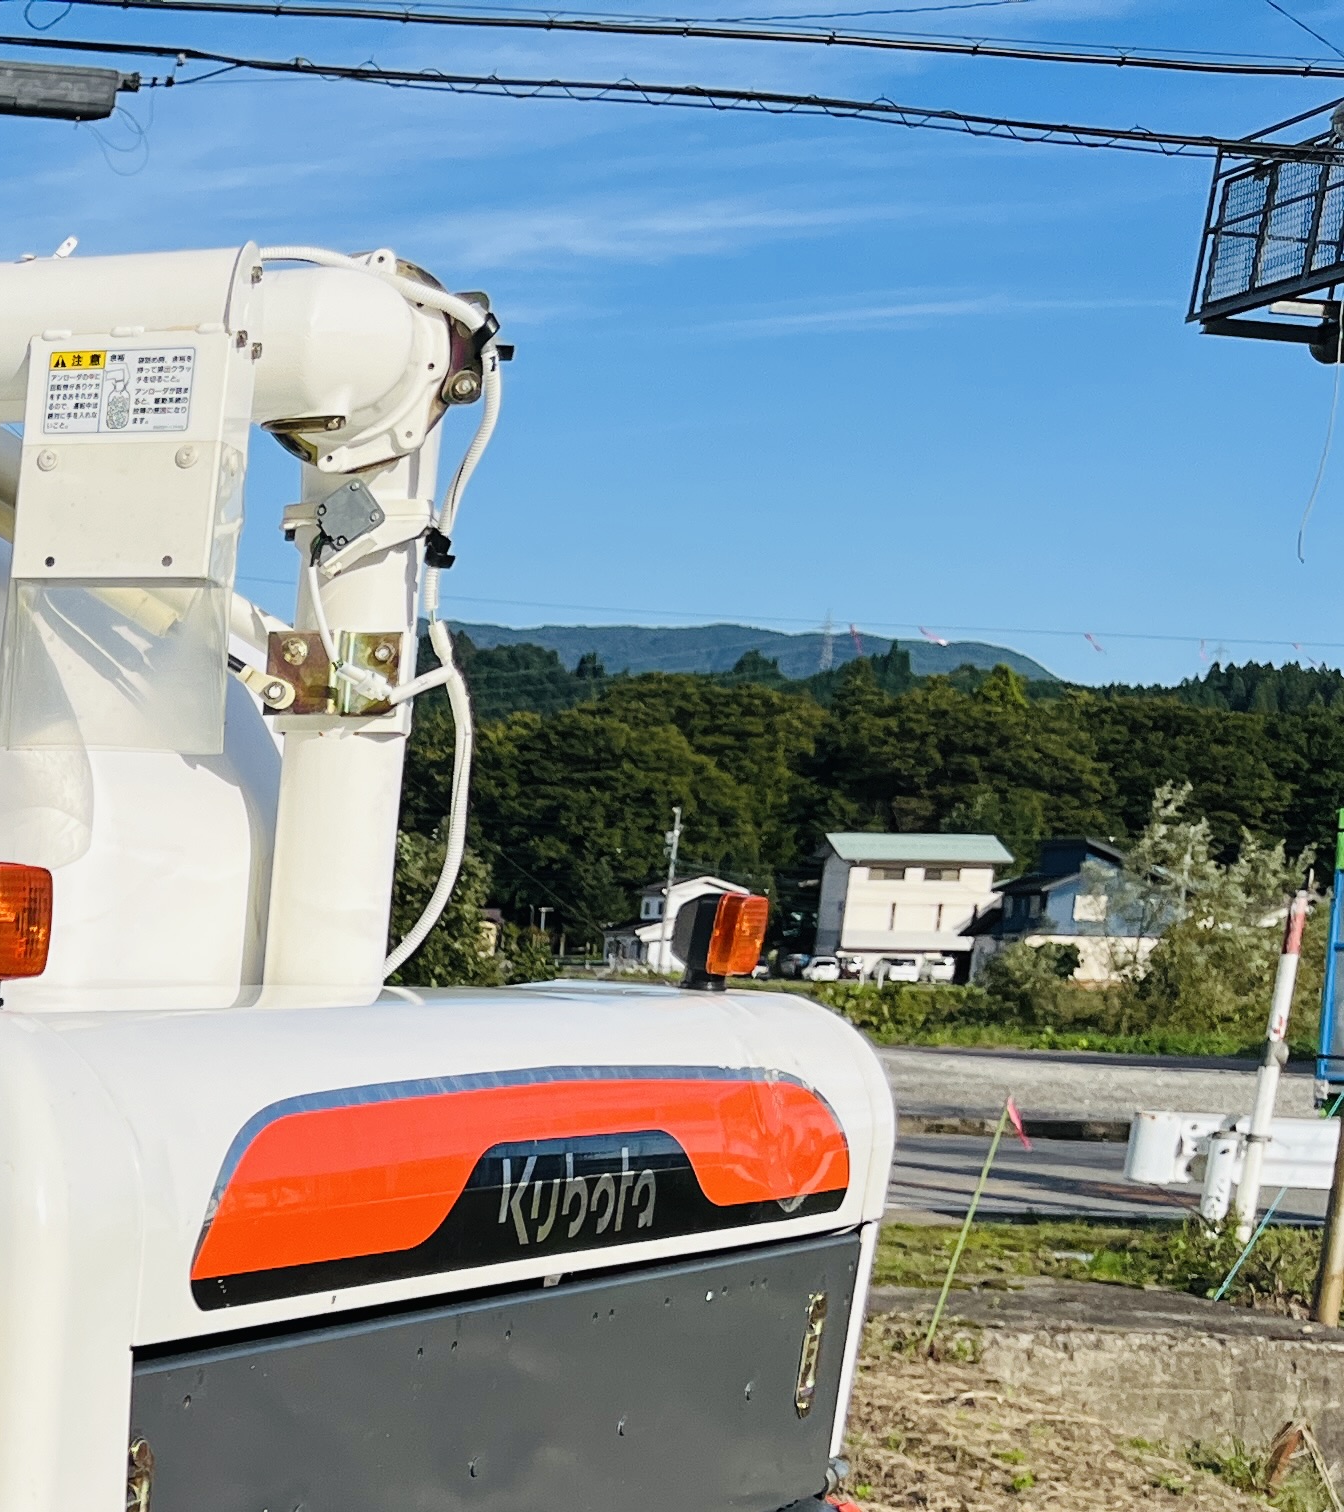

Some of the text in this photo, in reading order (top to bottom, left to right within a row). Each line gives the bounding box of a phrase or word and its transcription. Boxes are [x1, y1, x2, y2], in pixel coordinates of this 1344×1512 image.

[71, 354, 101, 366] 注意
[51, 374, 100, 382] アンローダの中に
[135, 375, 181, 383] チを切ること。
[135, 387, 189, 395] アンローダが詰ま
[49, 393, 99, 401] をするおそれがあ
[47, 412, 97, 420] 絶対に手を入れな
[132, 417, 149, 425] ます。
[46, 422, 68, 430] いこと。
[499, 1145, 657, 1246] Kubota
